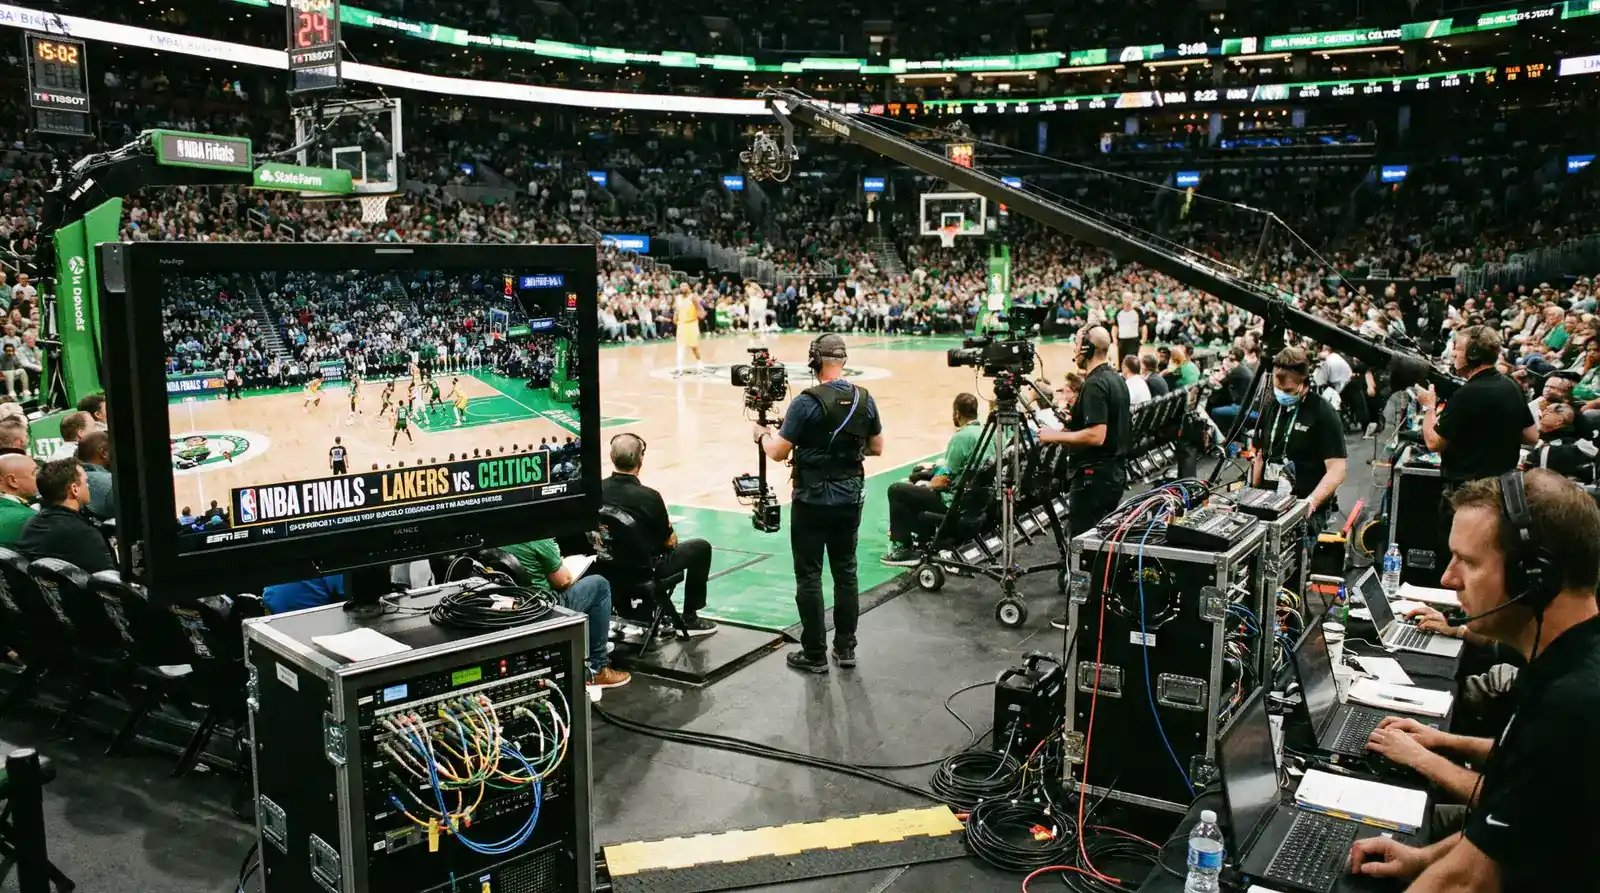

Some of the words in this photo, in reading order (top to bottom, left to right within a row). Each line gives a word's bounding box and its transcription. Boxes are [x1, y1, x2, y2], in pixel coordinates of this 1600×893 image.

[298, 12, 328, 47] 24
[1367, 28, 1402, 40] CELTICS
[37, 42, 78, 64] 15:02
[303, 50, 335, 62] TISSOT
[50, 94, 86, 105] TISSOT
[185, 140, 204, 159] NBA
[206, 142, 235, 162] Finals
[259, 484, 301, 519] NBA
[302, 476, 366, 513] FINALS
[381, 466, 450, 502] LAKERS
[452, 470, 475, 492] VS.
[477, 455, 542, 489] CELTICS
[541, 483, 568, 496] ESPN
[206, 532, 233, 544] ESPN
